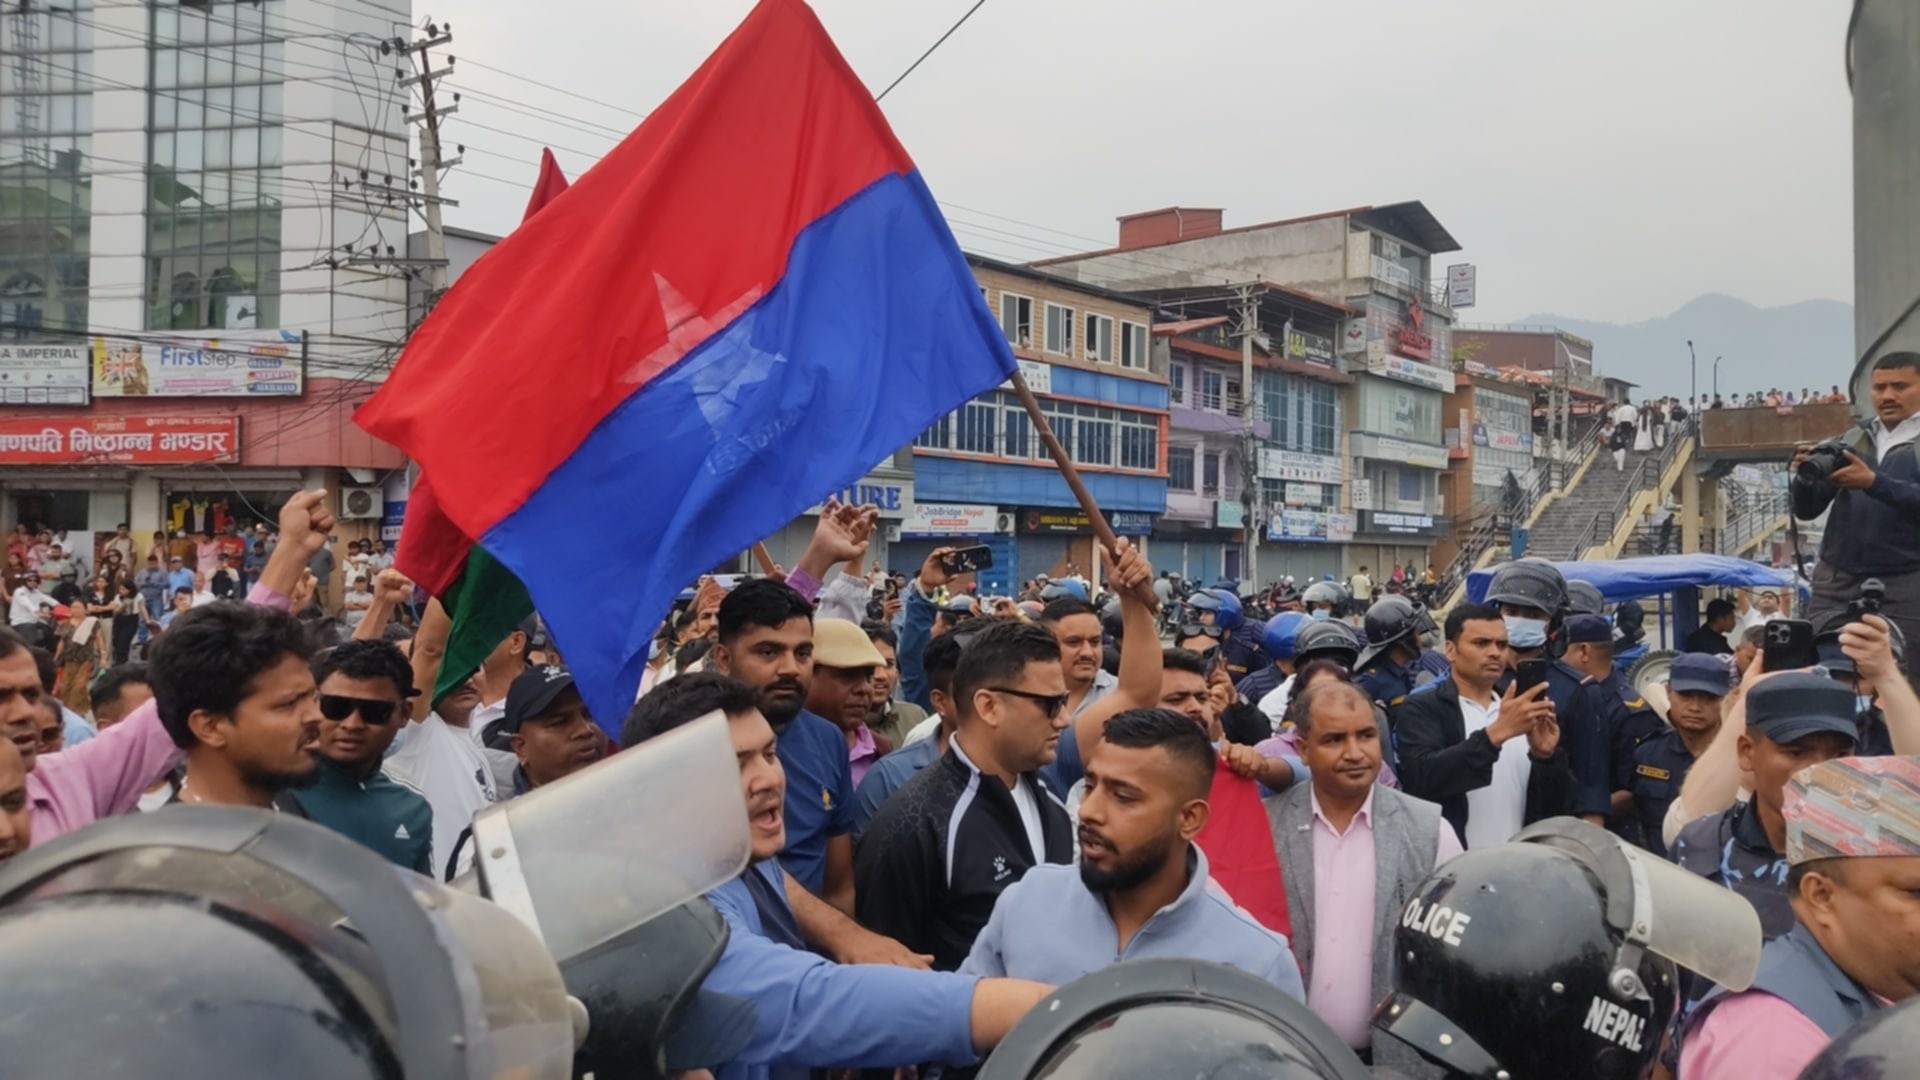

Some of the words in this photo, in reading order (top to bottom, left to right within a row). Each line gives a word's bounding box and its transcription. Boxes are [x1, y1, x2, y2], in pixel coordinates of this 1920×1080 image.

[16, 348, 79, 359] IMPERIAL
[160, 432, 229, 452] भण्डार
[1582, 995, 1646, 1053] NEPAL
